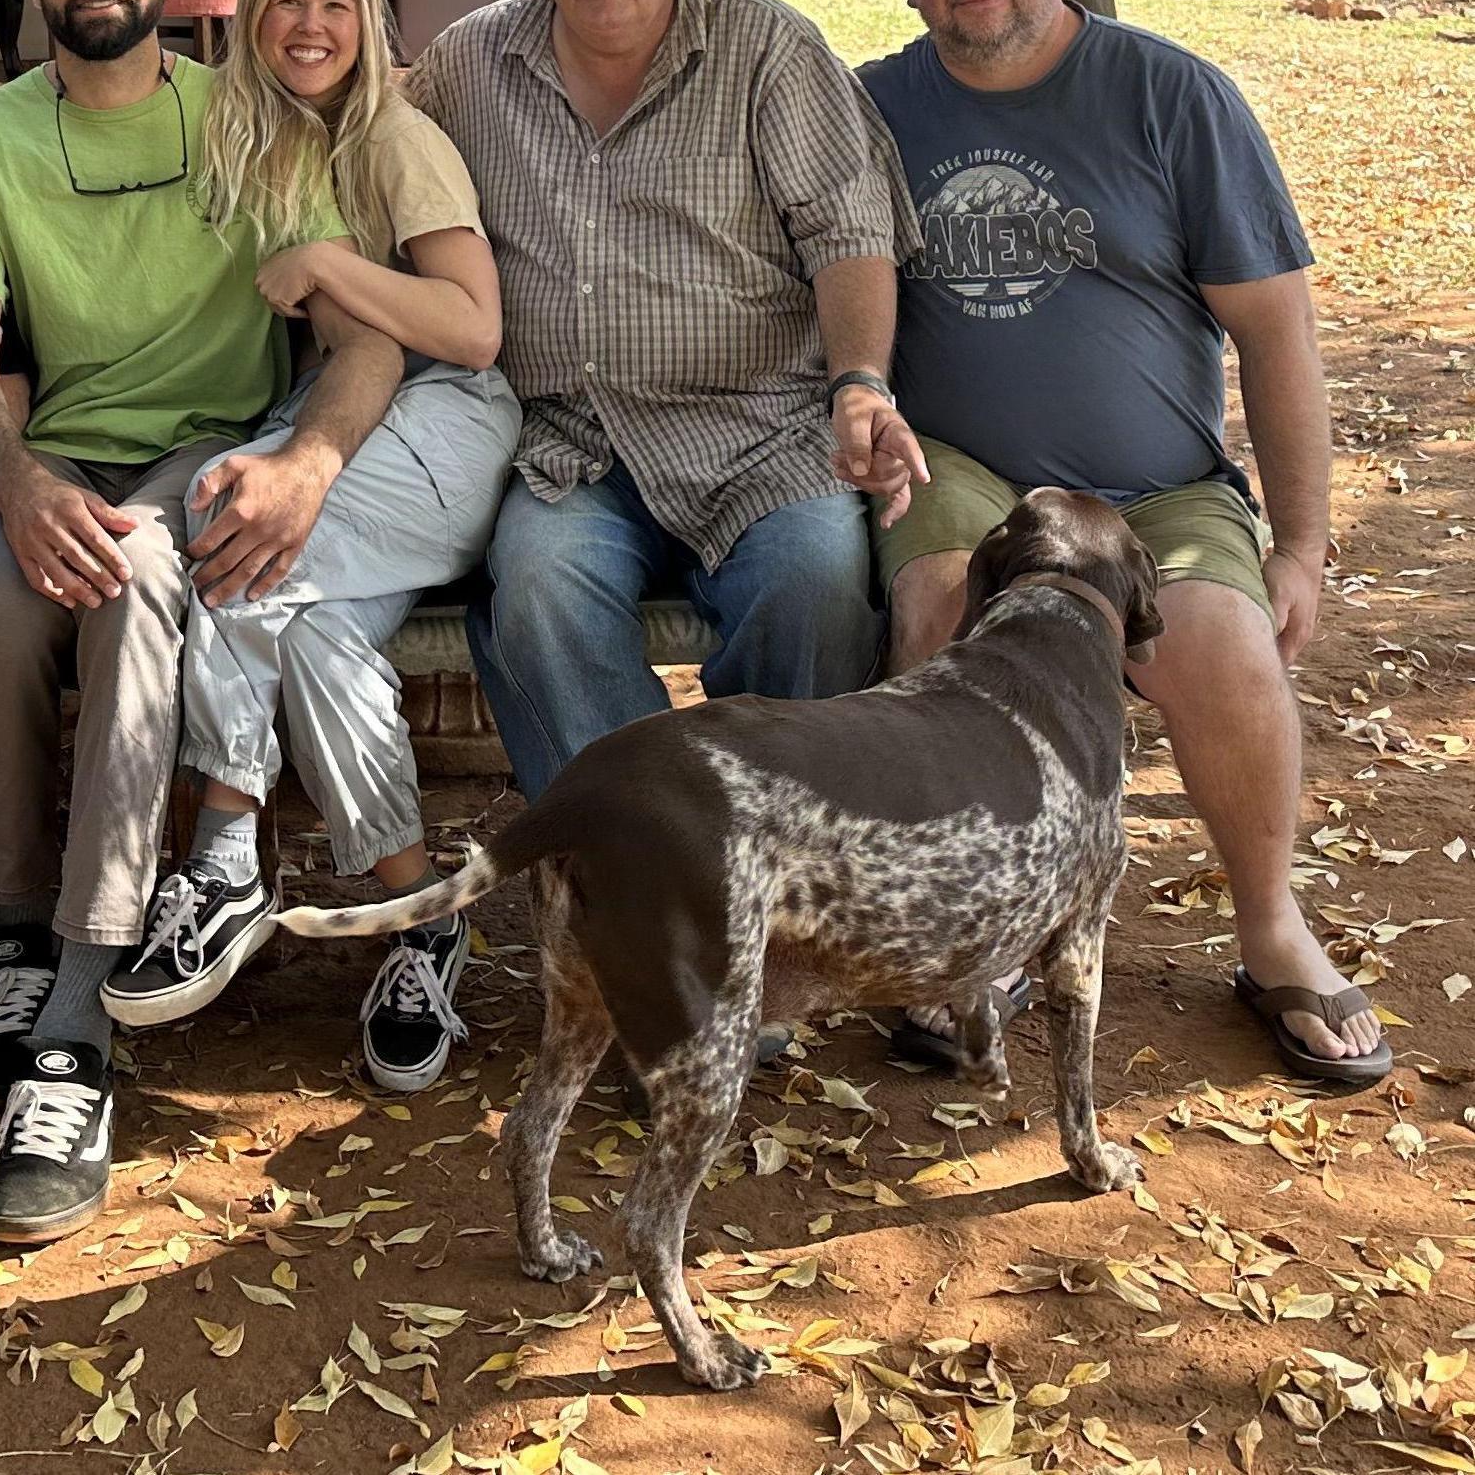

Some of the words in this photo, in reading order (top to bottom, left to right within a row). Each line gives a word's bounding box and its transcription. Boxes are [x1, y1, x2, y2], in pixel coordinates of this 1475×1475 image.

[929, 155, 963, 180] TREK
[967, 147, 1026, 165] JOUSELF
[1027, 159, 1056, 184] AAN
[904, 208, 1098, 280] AKIEBOS
[962, 299, 987, 319] VAN
[990, 301, 1016, 320] NOU
[1018, 298, 1034, 315] AF
